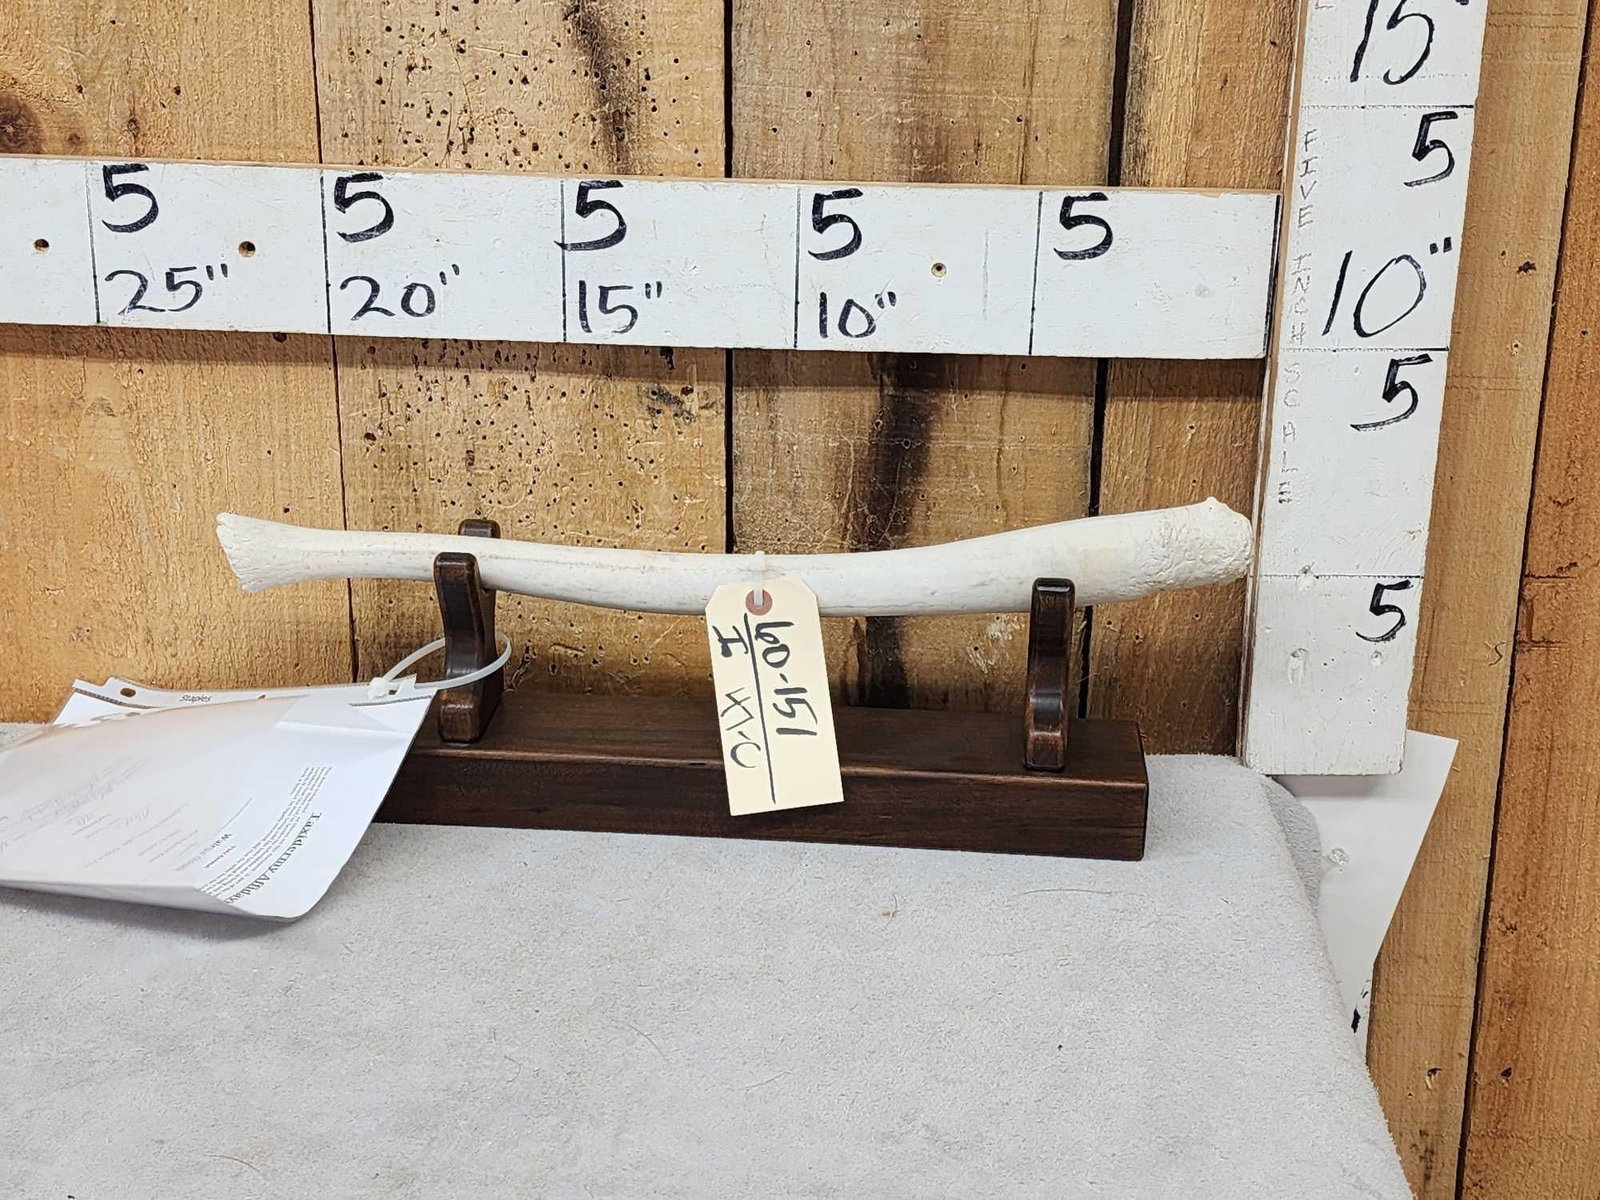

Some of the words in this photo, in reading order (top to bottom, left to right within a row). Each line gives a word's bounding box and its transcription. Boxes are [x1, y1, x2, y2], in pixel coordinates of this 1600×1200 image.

[1349, 0, 1470, 86] 15
[1298, 128, 1320, 229] FIVE
[1404, 110, 1458, 188] 5
[102, 162, 159, 234] 5
[333, 171, 395, 243] 5
[554, 179, 628, 252] 5
[807, 187, 864, 261] 5
[1053, 191, 1113, 261] 5
[104, 263, 229, 315] 25"
[339, 263, 460, 321] 20"
[578, 279, 663, 334] 15"
[818, 290, 897, 339] 10"
[1321, 236, 1453, 338] 10"
[1349, 353, 1434, 432] 5
[1355, 579, 1414, 643] 5
[754, 620, 819, 737] 60-151
[267, 811, 322, 874] Taxidermy
